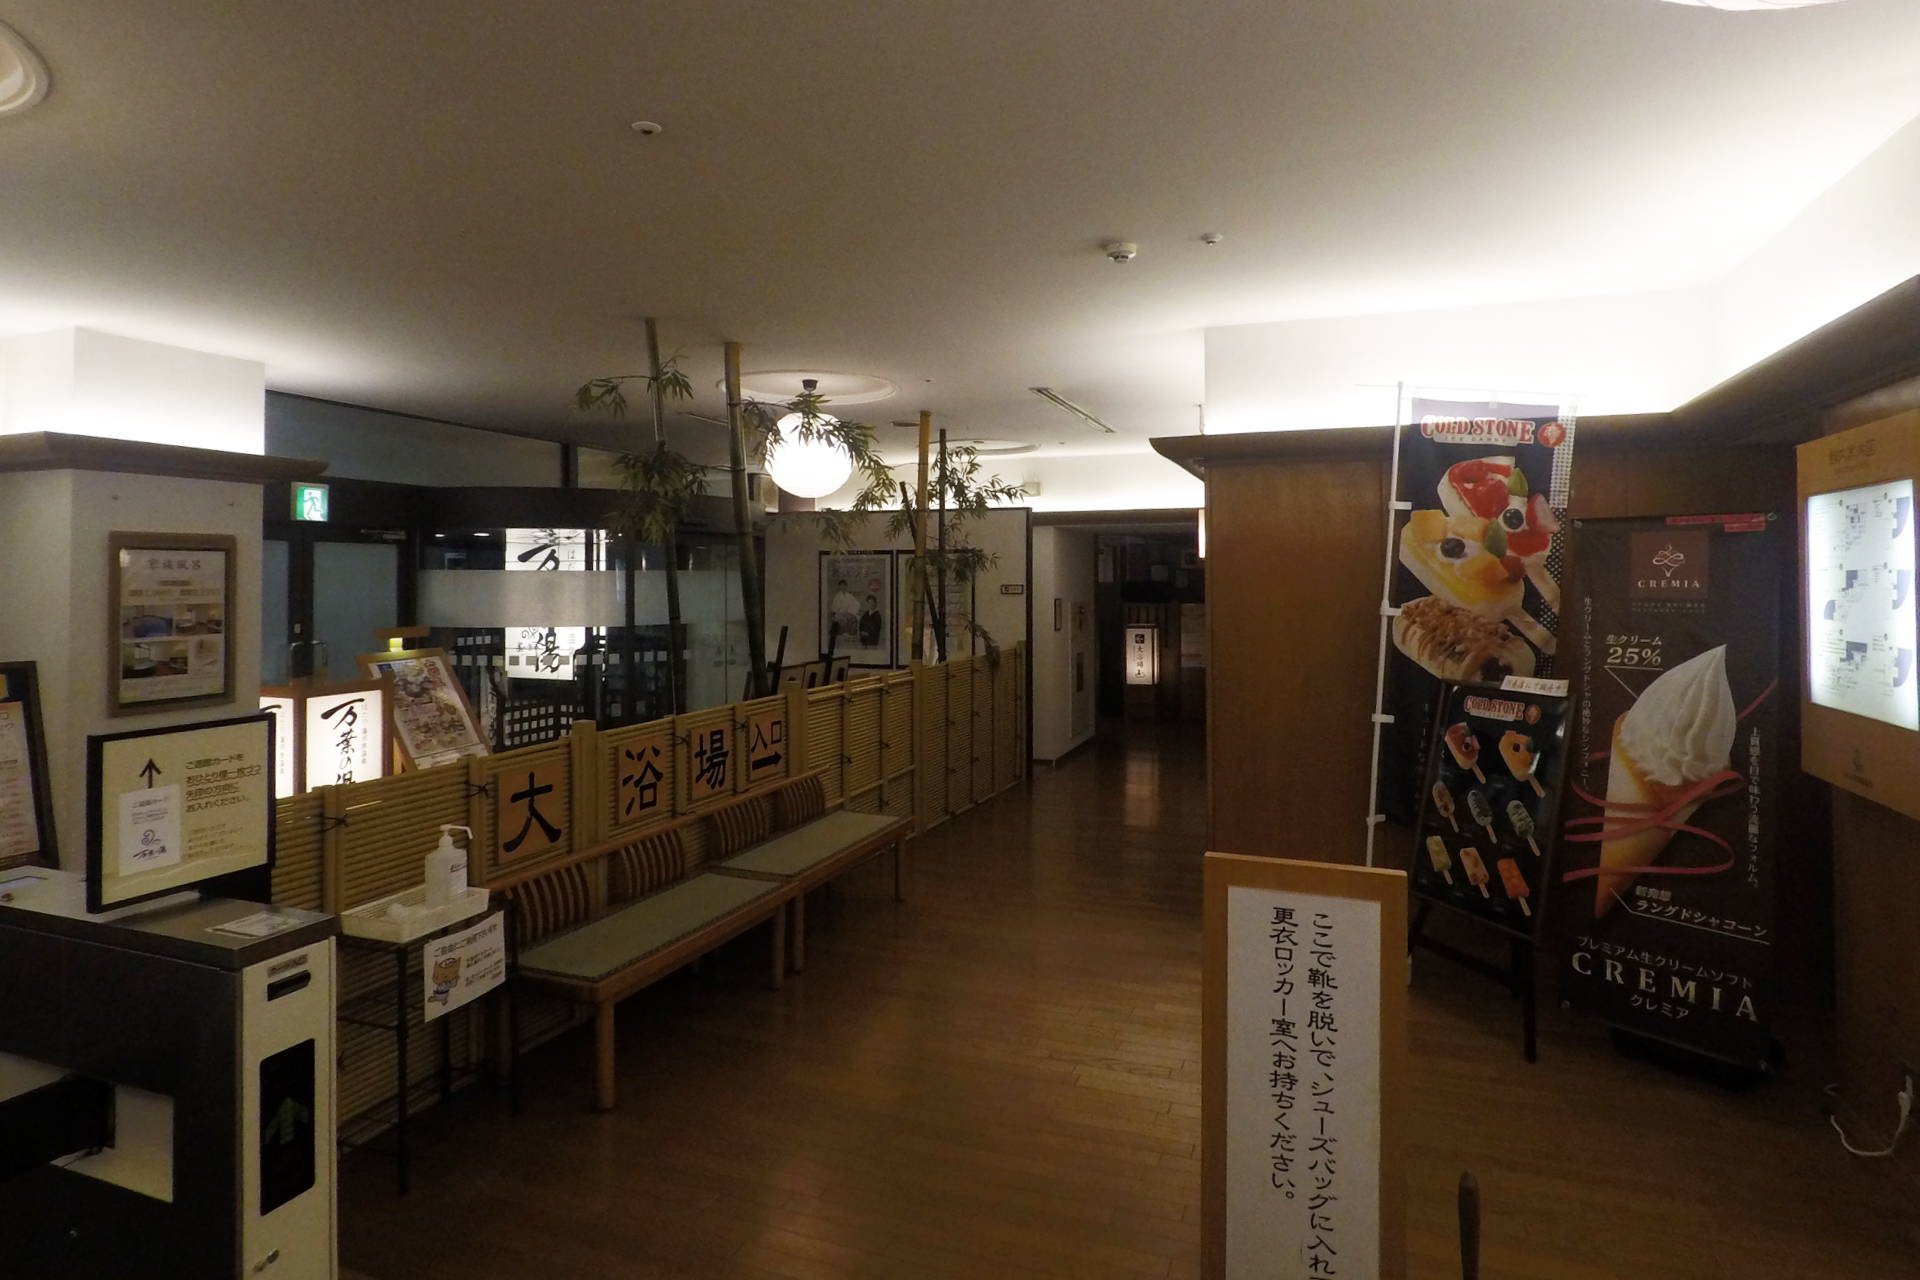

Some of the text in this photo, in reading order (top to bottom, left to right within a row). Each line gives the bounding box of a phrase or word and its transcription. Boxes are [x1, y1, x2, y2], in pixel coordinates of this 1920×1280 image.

[1472, 418, 1533, 443] STONE
[1637, 579, 1701, 589] CREMIA
[1605, 633, 1663, 646] 生クリーム
[1606, 646, 1662, 667] 25%
[1490, 699, 1524, 720] STONE
[1637, 899, 1767, 936] ラングドシャコーン
[1577, 936, 1753, 989] プレミアム生クリームソフト
[1571, 951, 1759, 1023] CREMIA
[1629, 994, 1689, 1020] クレミア
[1269, 907, 1298, 1199] 更衣ロッカー室へお持ちください。
[1307, 913, 1339, 1280] ここで靴を脱いで、シューズバッグに入れ
